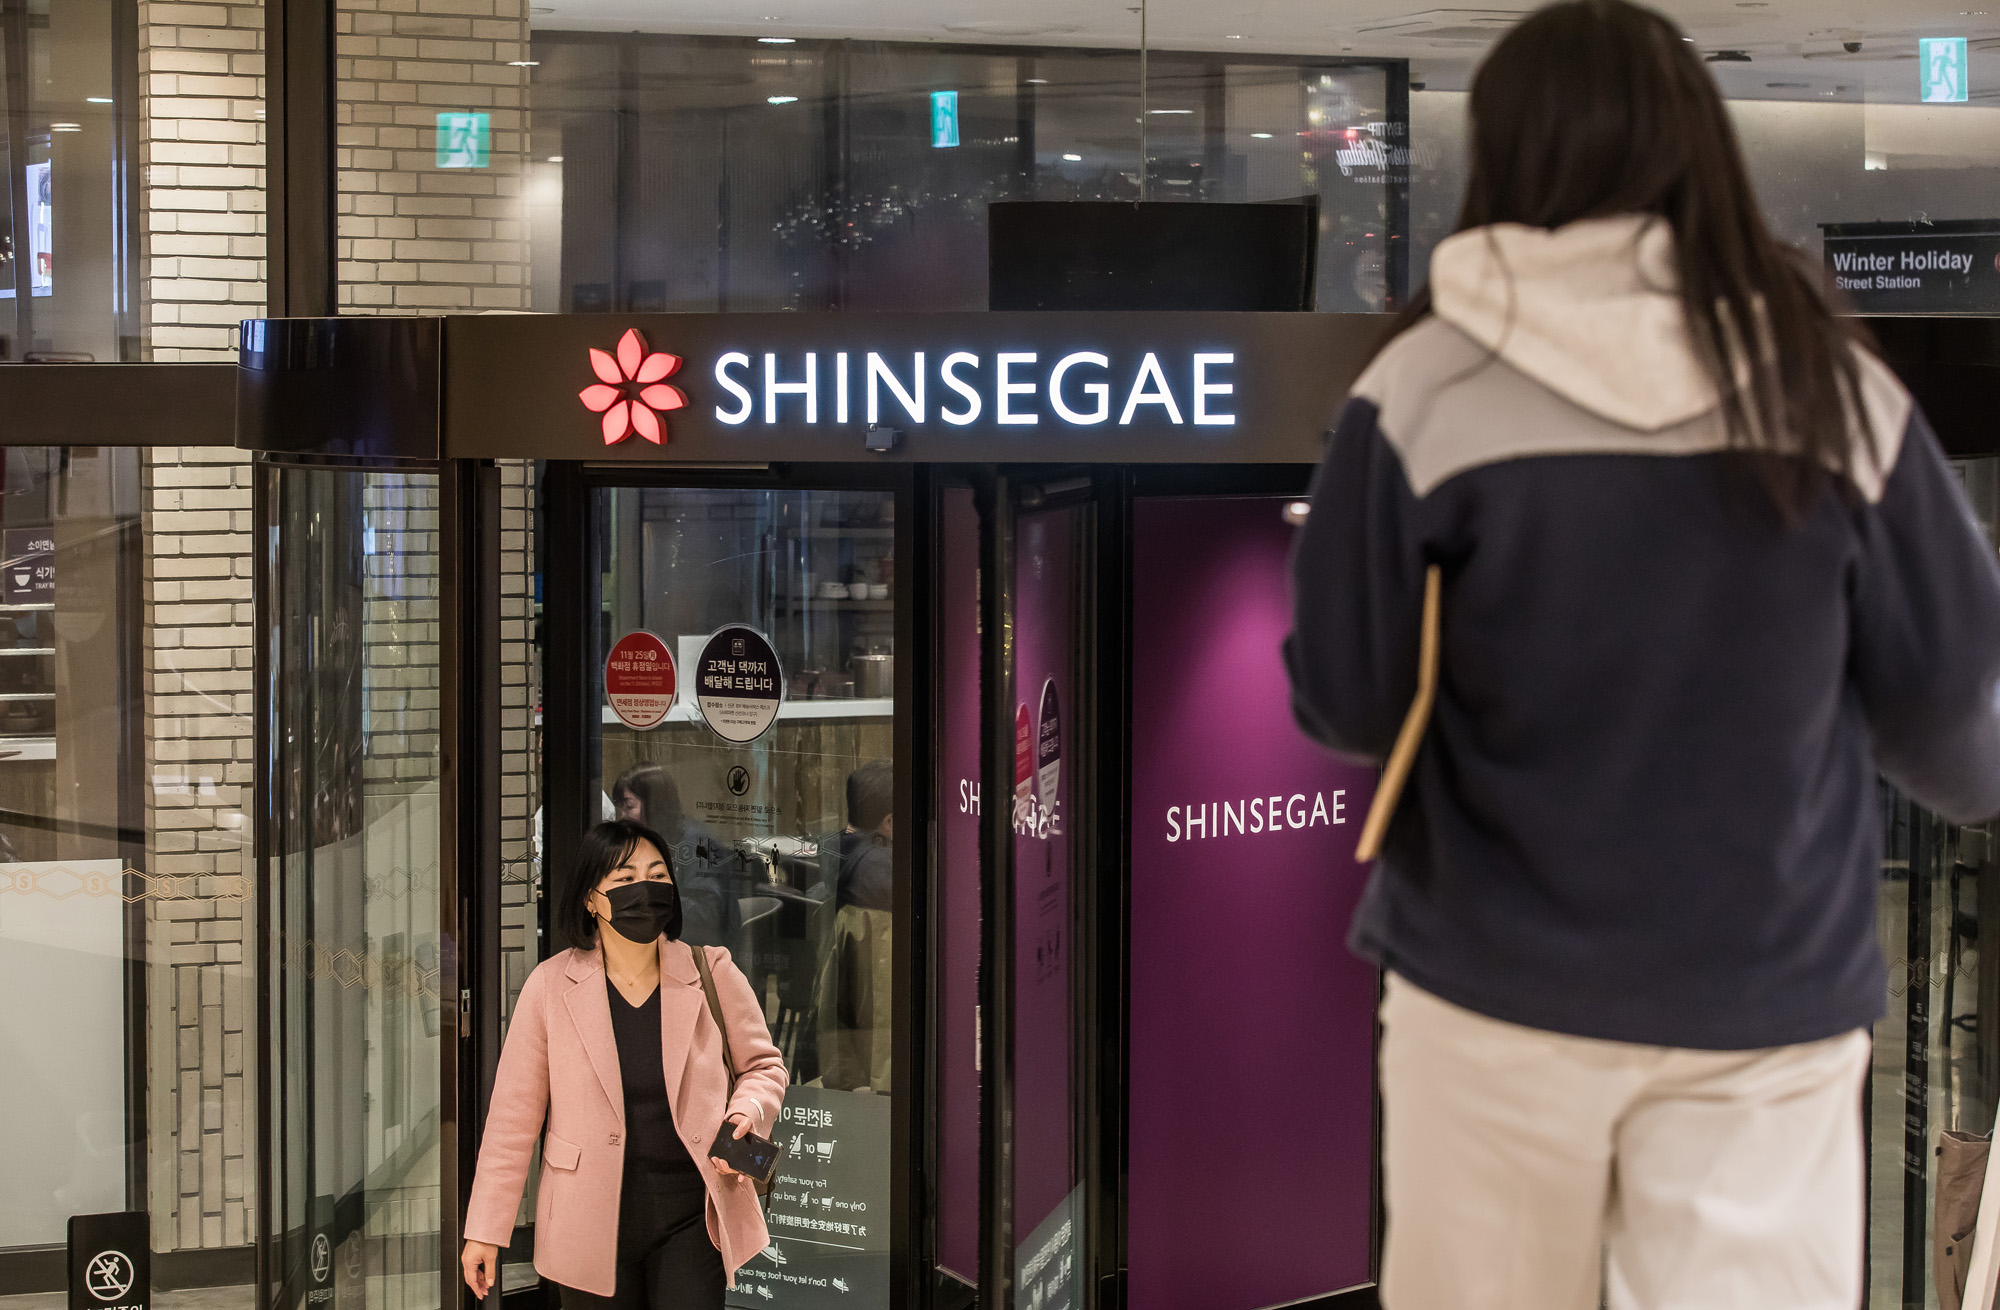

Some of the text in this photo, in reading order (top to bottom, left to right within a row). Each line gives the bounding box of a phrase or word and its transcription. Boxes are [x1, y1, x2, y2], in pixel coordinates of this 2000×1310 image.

[1833, 250, 1973, 274] Winter Holiday
[1835, 275, 1921, 289] Street Station
[714, 351, 1236, 425] SHINSEGAE
[36, 566, 54, 579] 식기
[610, 661, 670, 672] 백화점 휴점일입니다
[707, 659, 767, 675] 고객님 댁까지
[704, 675, 774, 692] 배달해 드립니다
[959, 778, 981, 817] SH
[1166, 789, 1347, 843] SHINSEGAE
